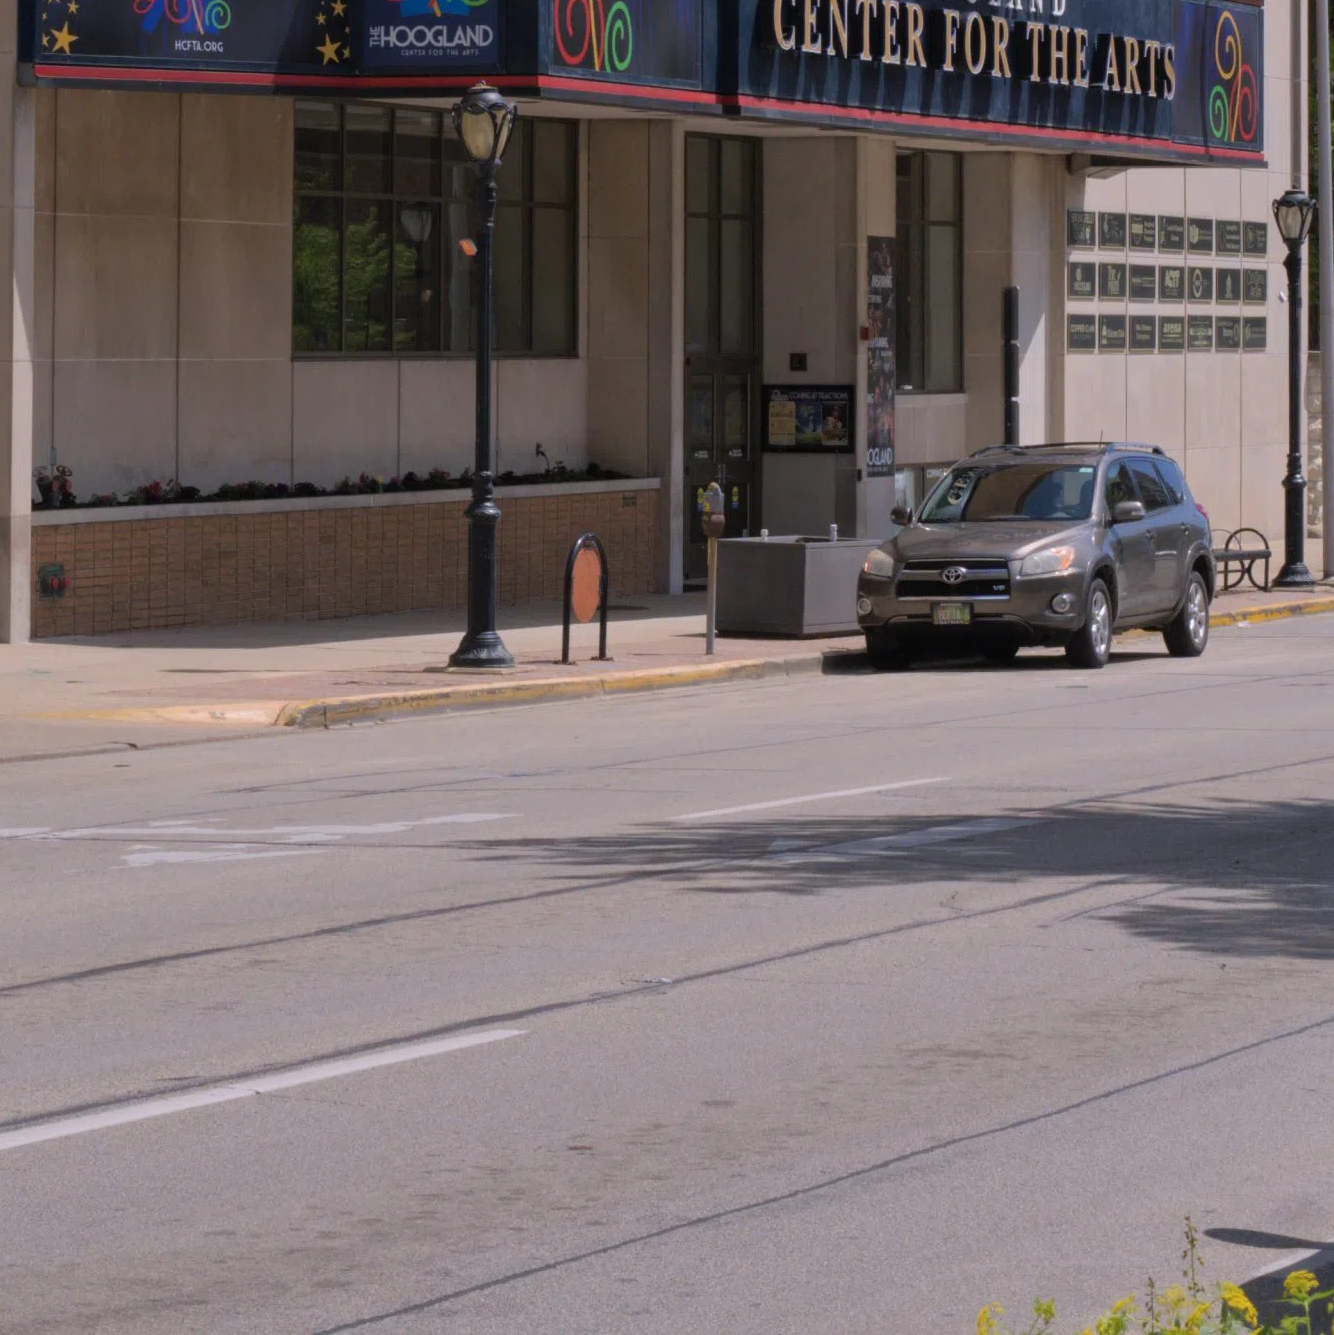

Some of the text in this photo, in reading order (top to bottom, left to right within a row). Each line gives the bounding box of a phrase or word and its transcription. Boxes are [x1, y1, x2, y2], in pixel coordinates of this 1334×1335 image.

[175, 39, 224, 53] HCFTA.ORG
[369, 25, 380, 47] THE
[380, 24, 493, 47] HOOGLAND
[429, 48, 443, 56] FOR
[447, 48, 459, 56] THE
[462, 48, 479, 56] ARTS
[943, 9, 1012, 78] FOR
[1026, 21, 1090, 88] THE
[1102, 33, 1175, 100] ARTS
